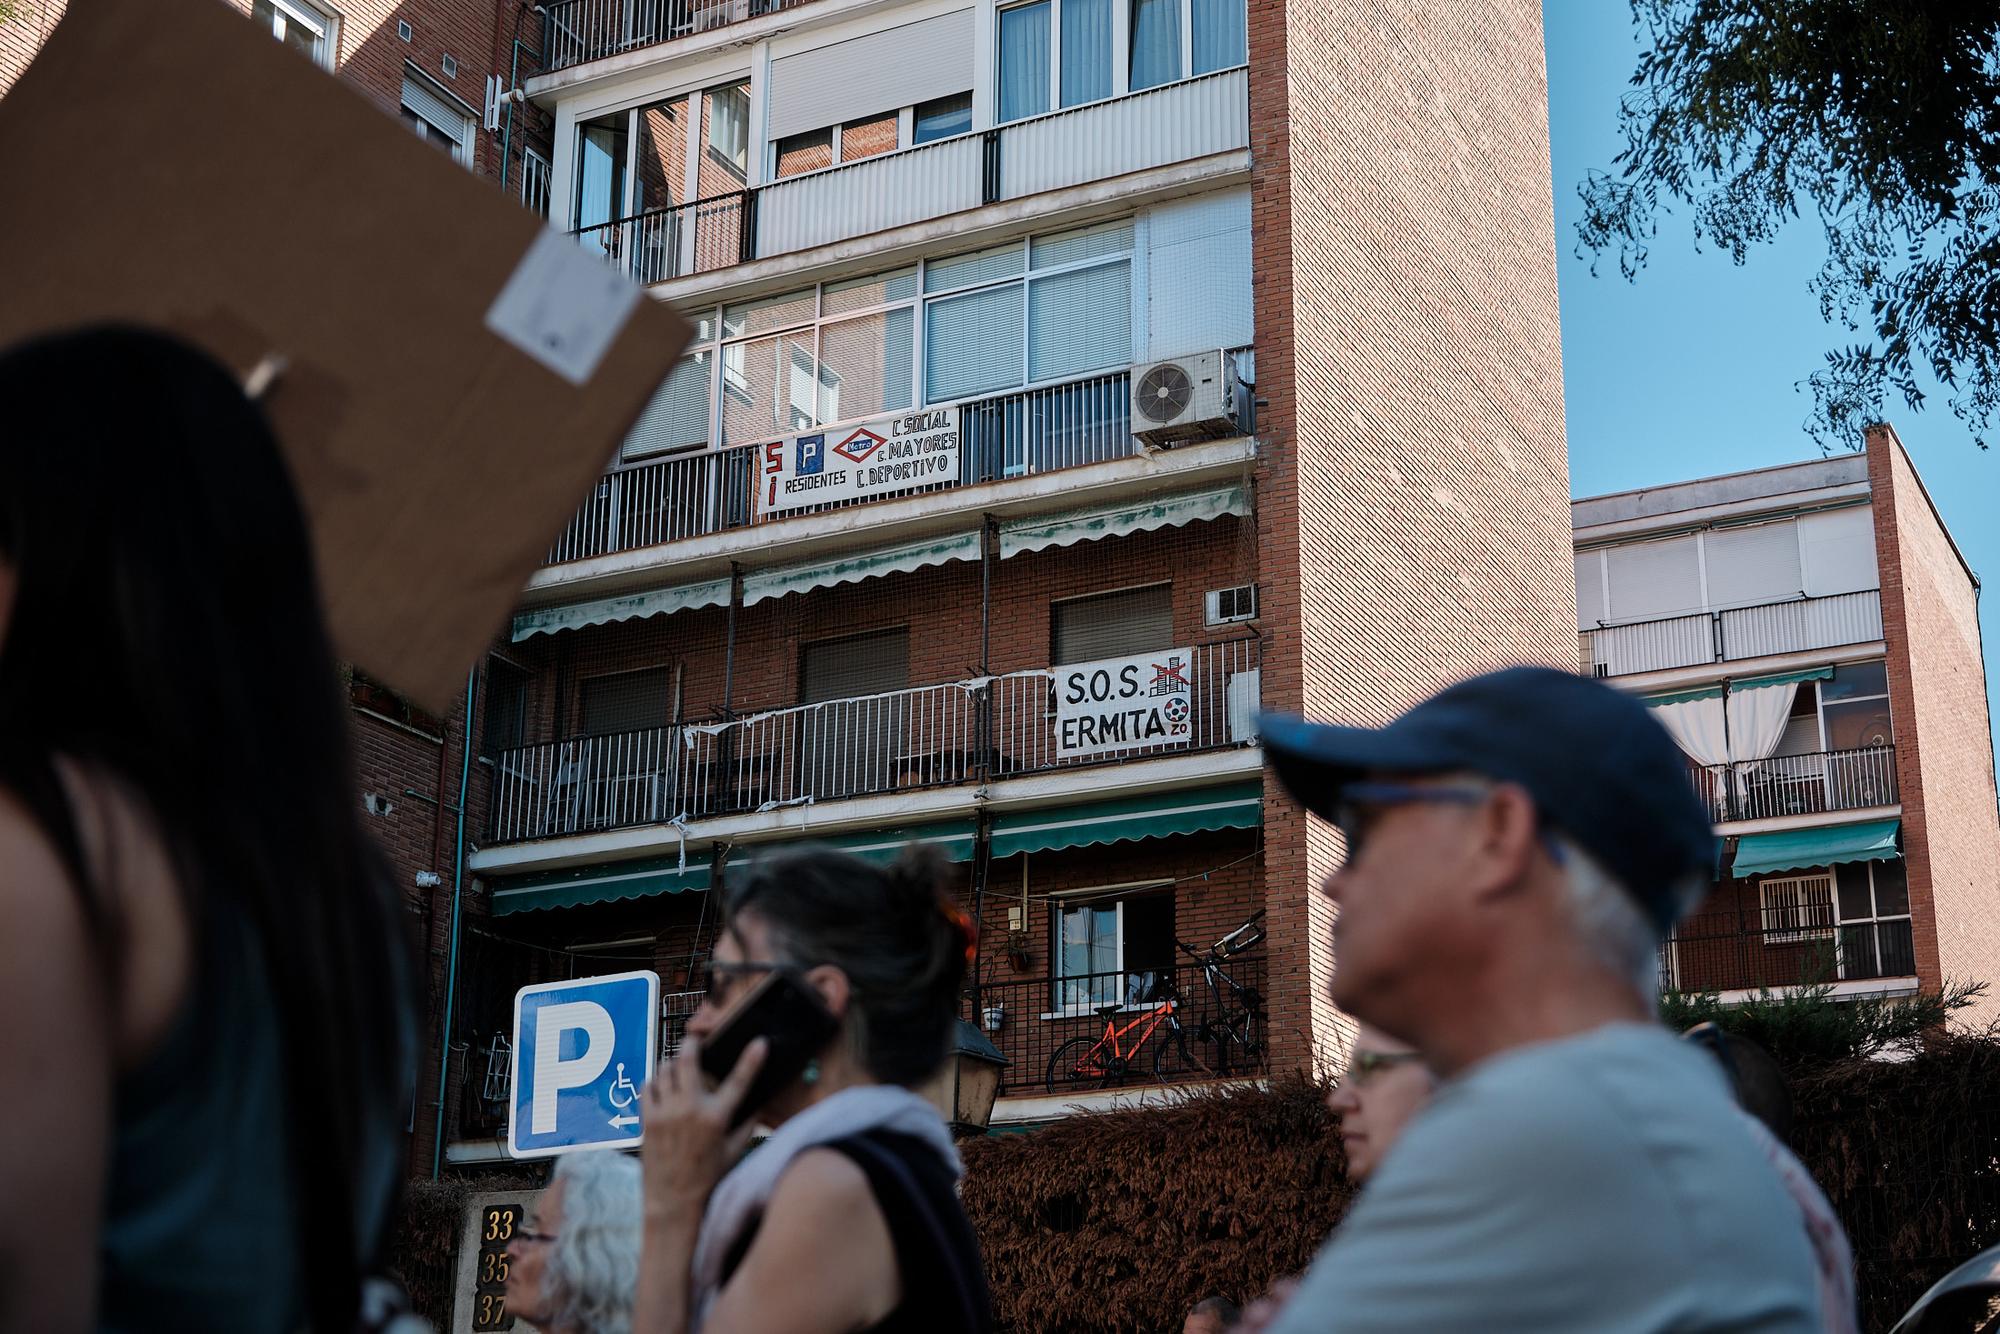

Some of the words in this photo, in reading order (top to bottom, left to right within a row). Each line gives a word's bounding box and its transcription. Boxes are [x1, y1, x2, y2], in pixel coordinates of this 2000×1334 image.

[803, 443, 816, 468] P
[1066, 665, 1145, 704] S.O.S.
[1062, 708, 1166, 750] ERMITA
[532, 1001, 615, 1135] P
[486, 1211, 513, 1240] 33
[483, 1254, 509, 1283] 35
[479, 1295, 506, 1325] 37
